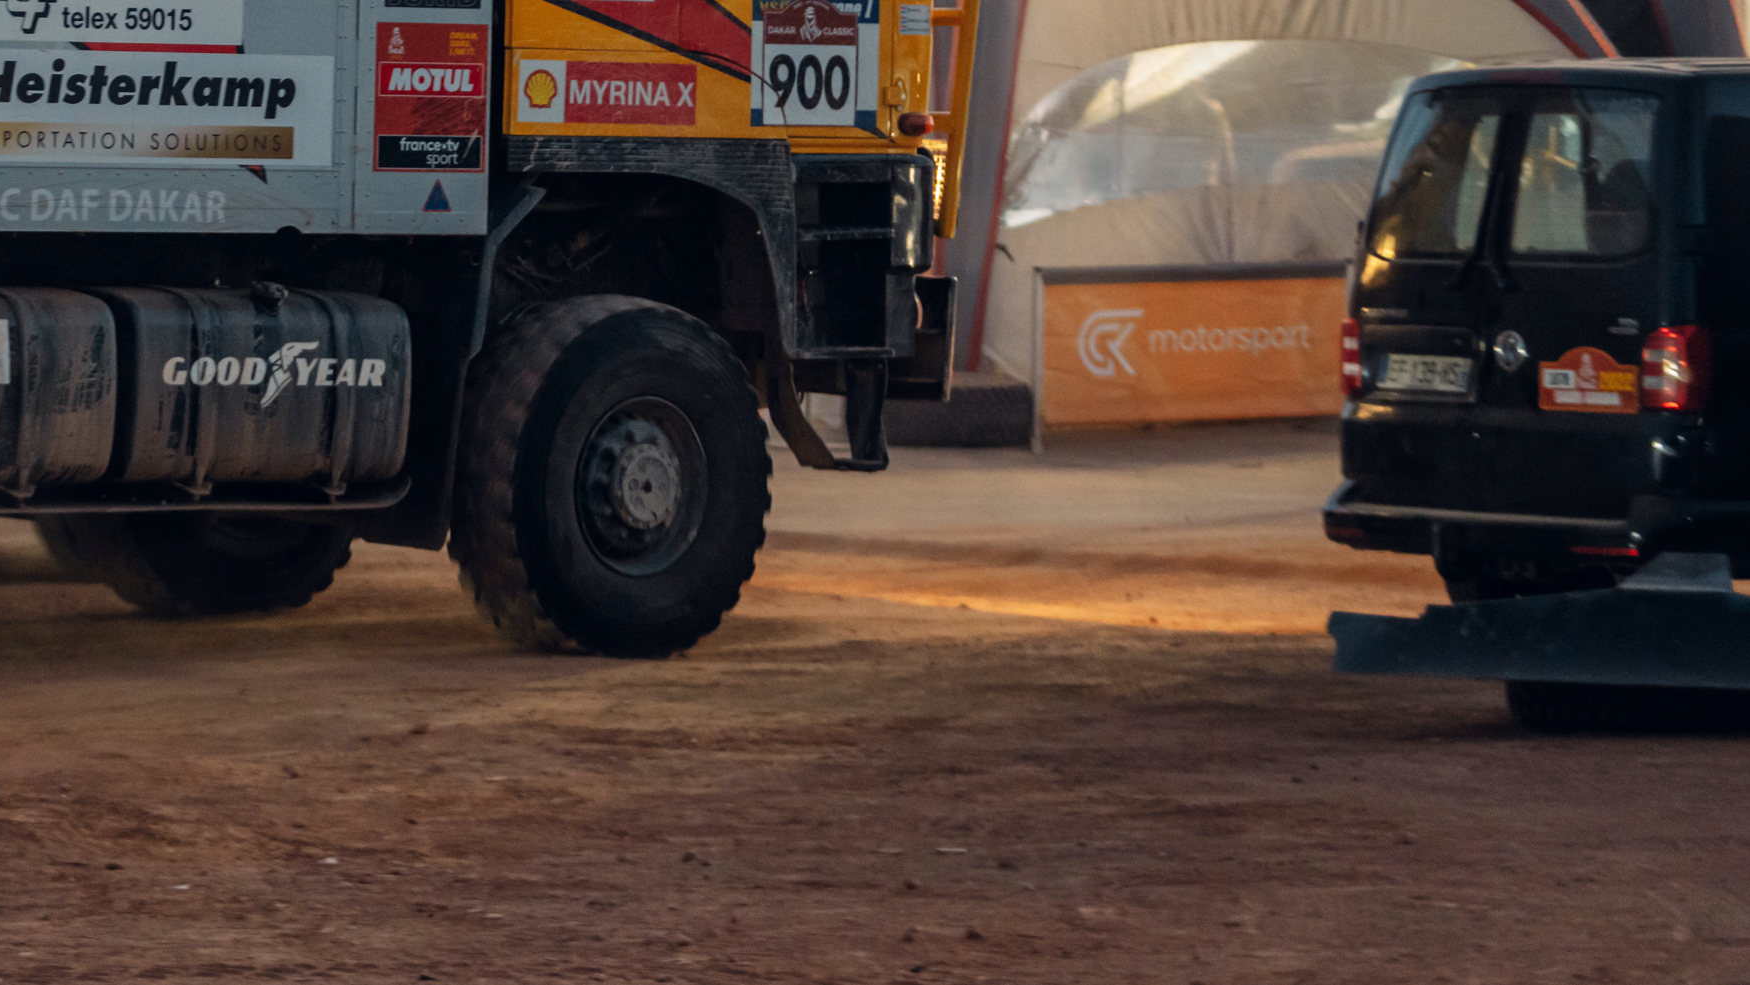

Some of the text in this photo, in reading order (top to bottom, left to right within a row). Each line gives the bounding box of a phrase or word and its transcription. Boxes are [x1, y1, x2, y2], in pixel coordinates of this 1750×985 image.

[62, 7, 192, 31] telex 59015
[768, 26, 855, 36] DAKAR CLASSIC
[388, 68, 473, 92] MOTUL
[769, 54, 849, 110] 900
[569, 80, 694, 107] MYRINA X
[150, 132, 282, 152] SOLUTIONS
[426, 154, 458, 168] sport
[30, 189, 100, 222] DAF
[109, 190, 226, 223] DAKAR
[1150, 324, 1310, 357] motorsport
[162, 356, 386, 387] GOOD YEAR
